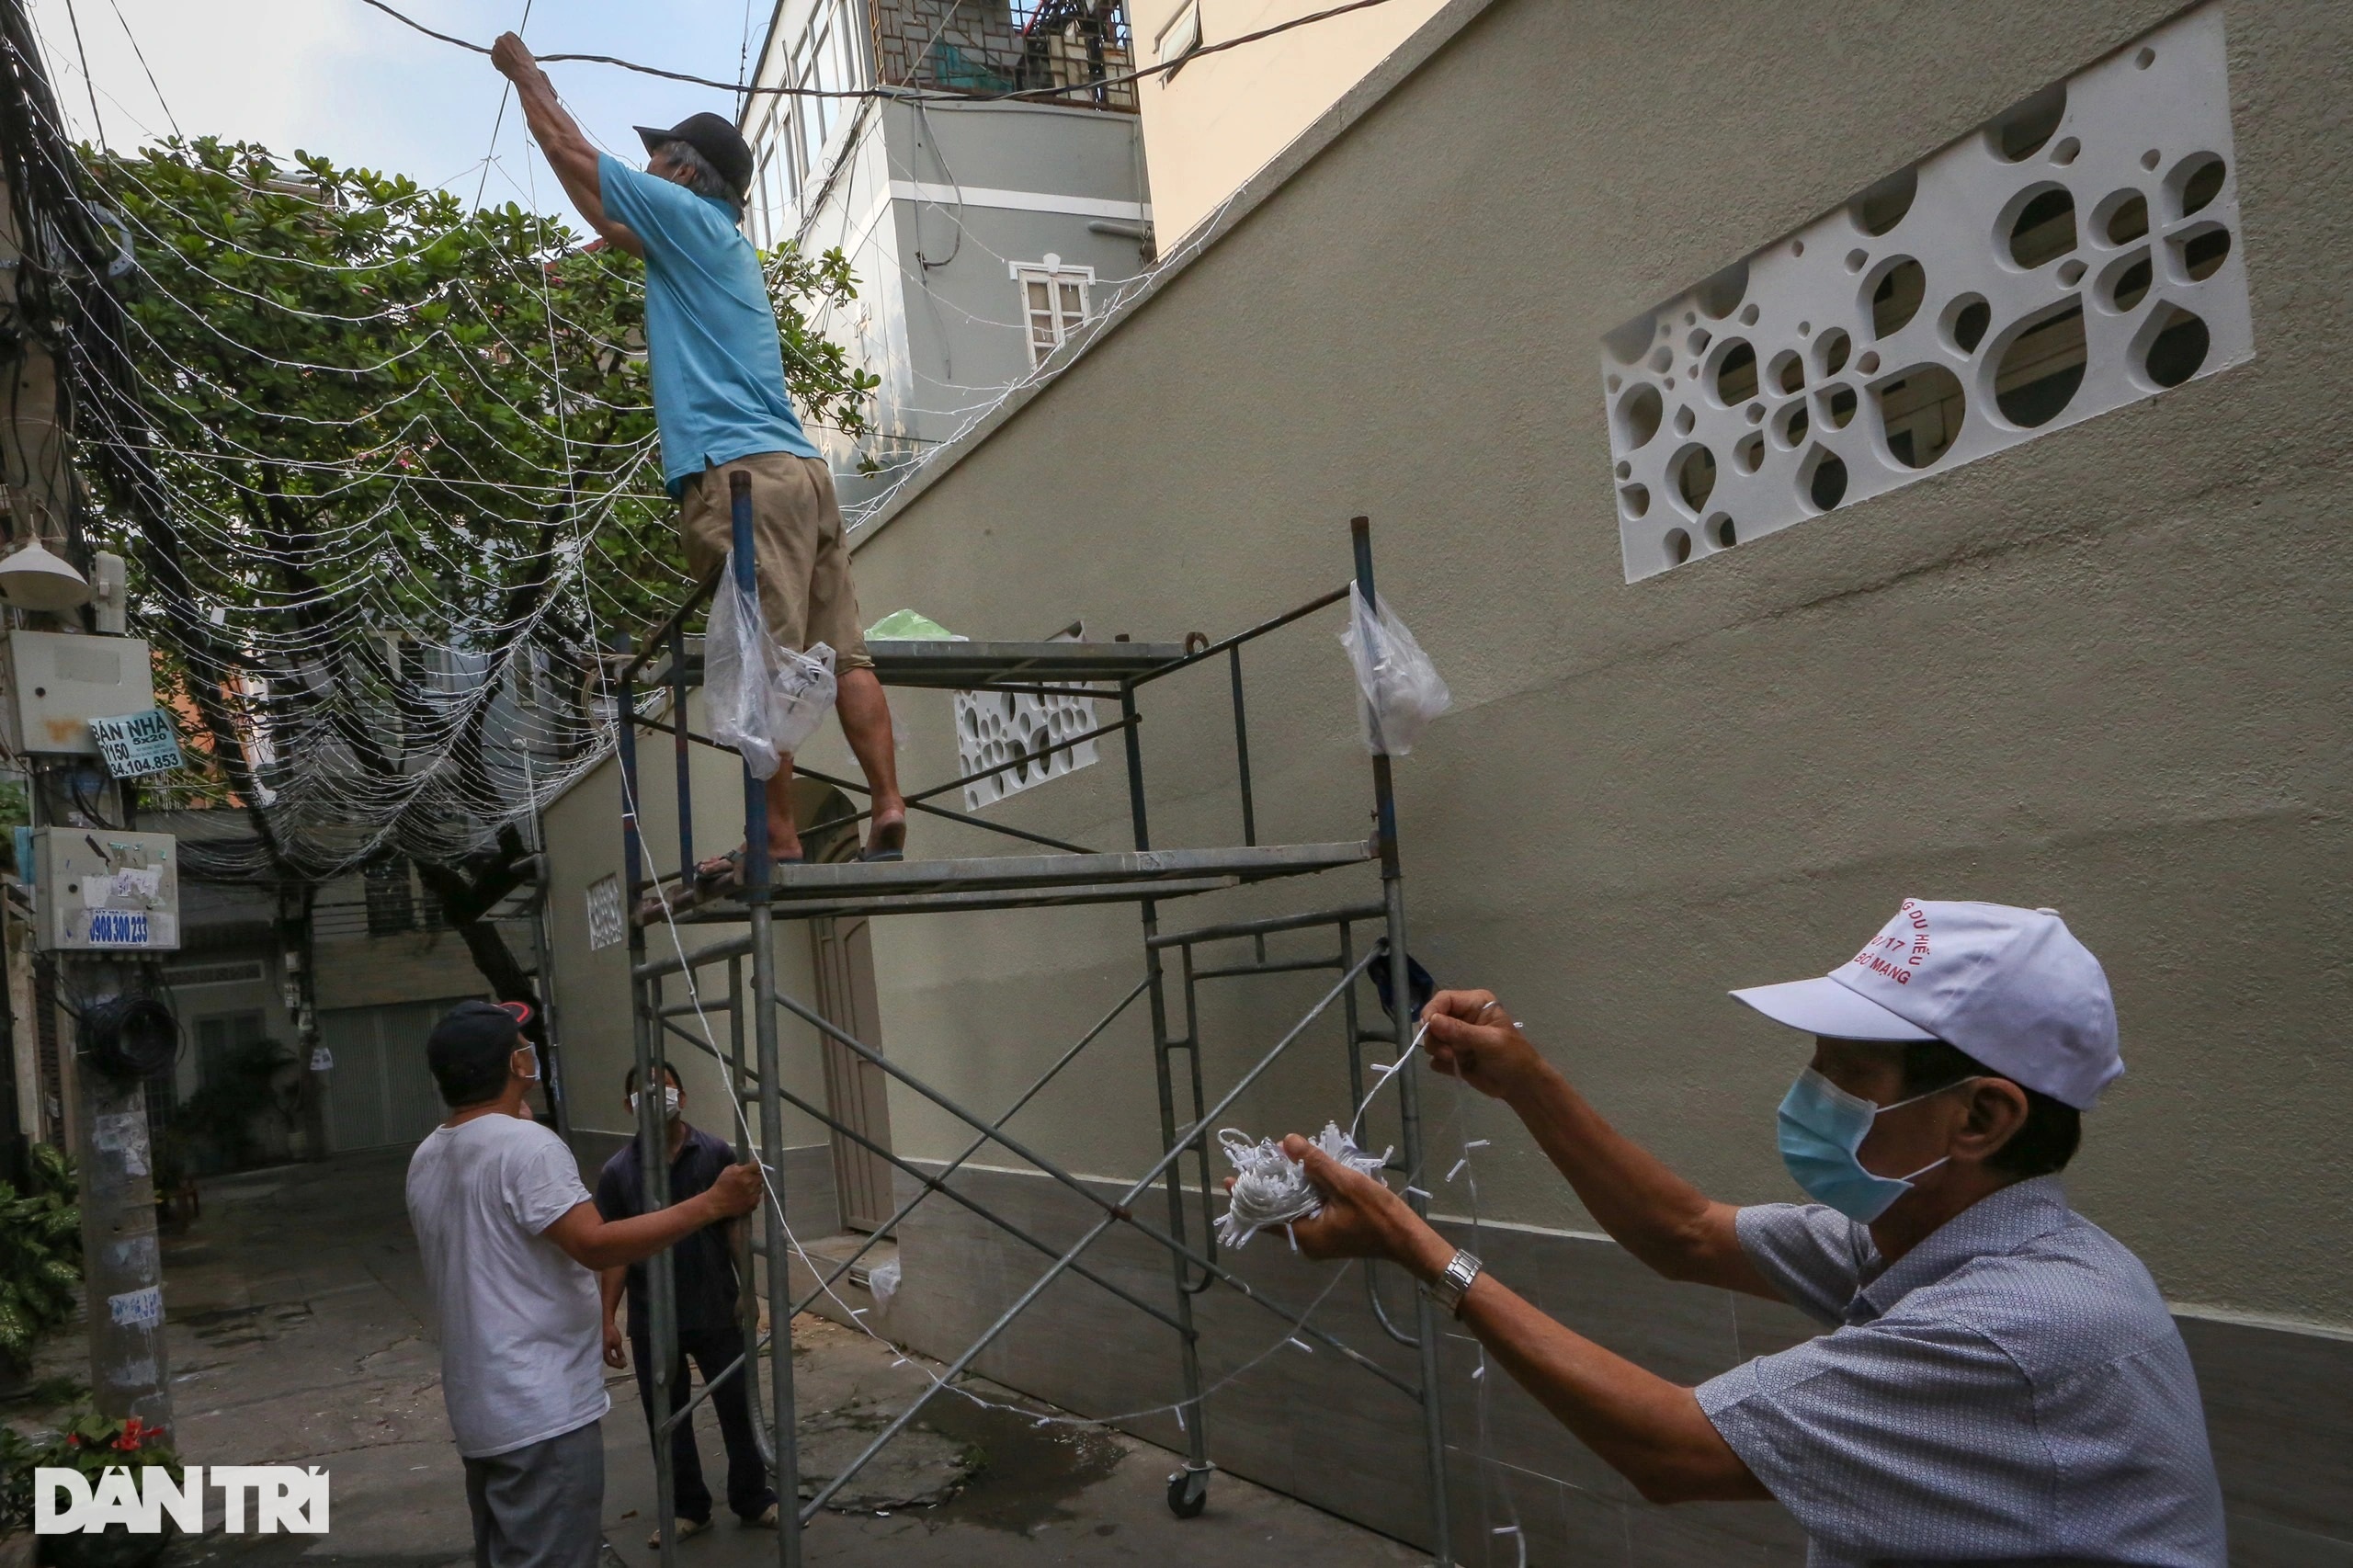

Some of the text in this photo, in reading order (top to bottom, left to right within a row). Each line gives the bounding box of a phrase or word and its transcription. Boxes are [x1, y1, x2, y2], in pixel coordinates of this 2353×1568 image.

[91, 711, 169, 744] BÁN NHÀ
[132, 733, 167, 745] 5x20
[1869, 957, 1912, 985] MẠNG
